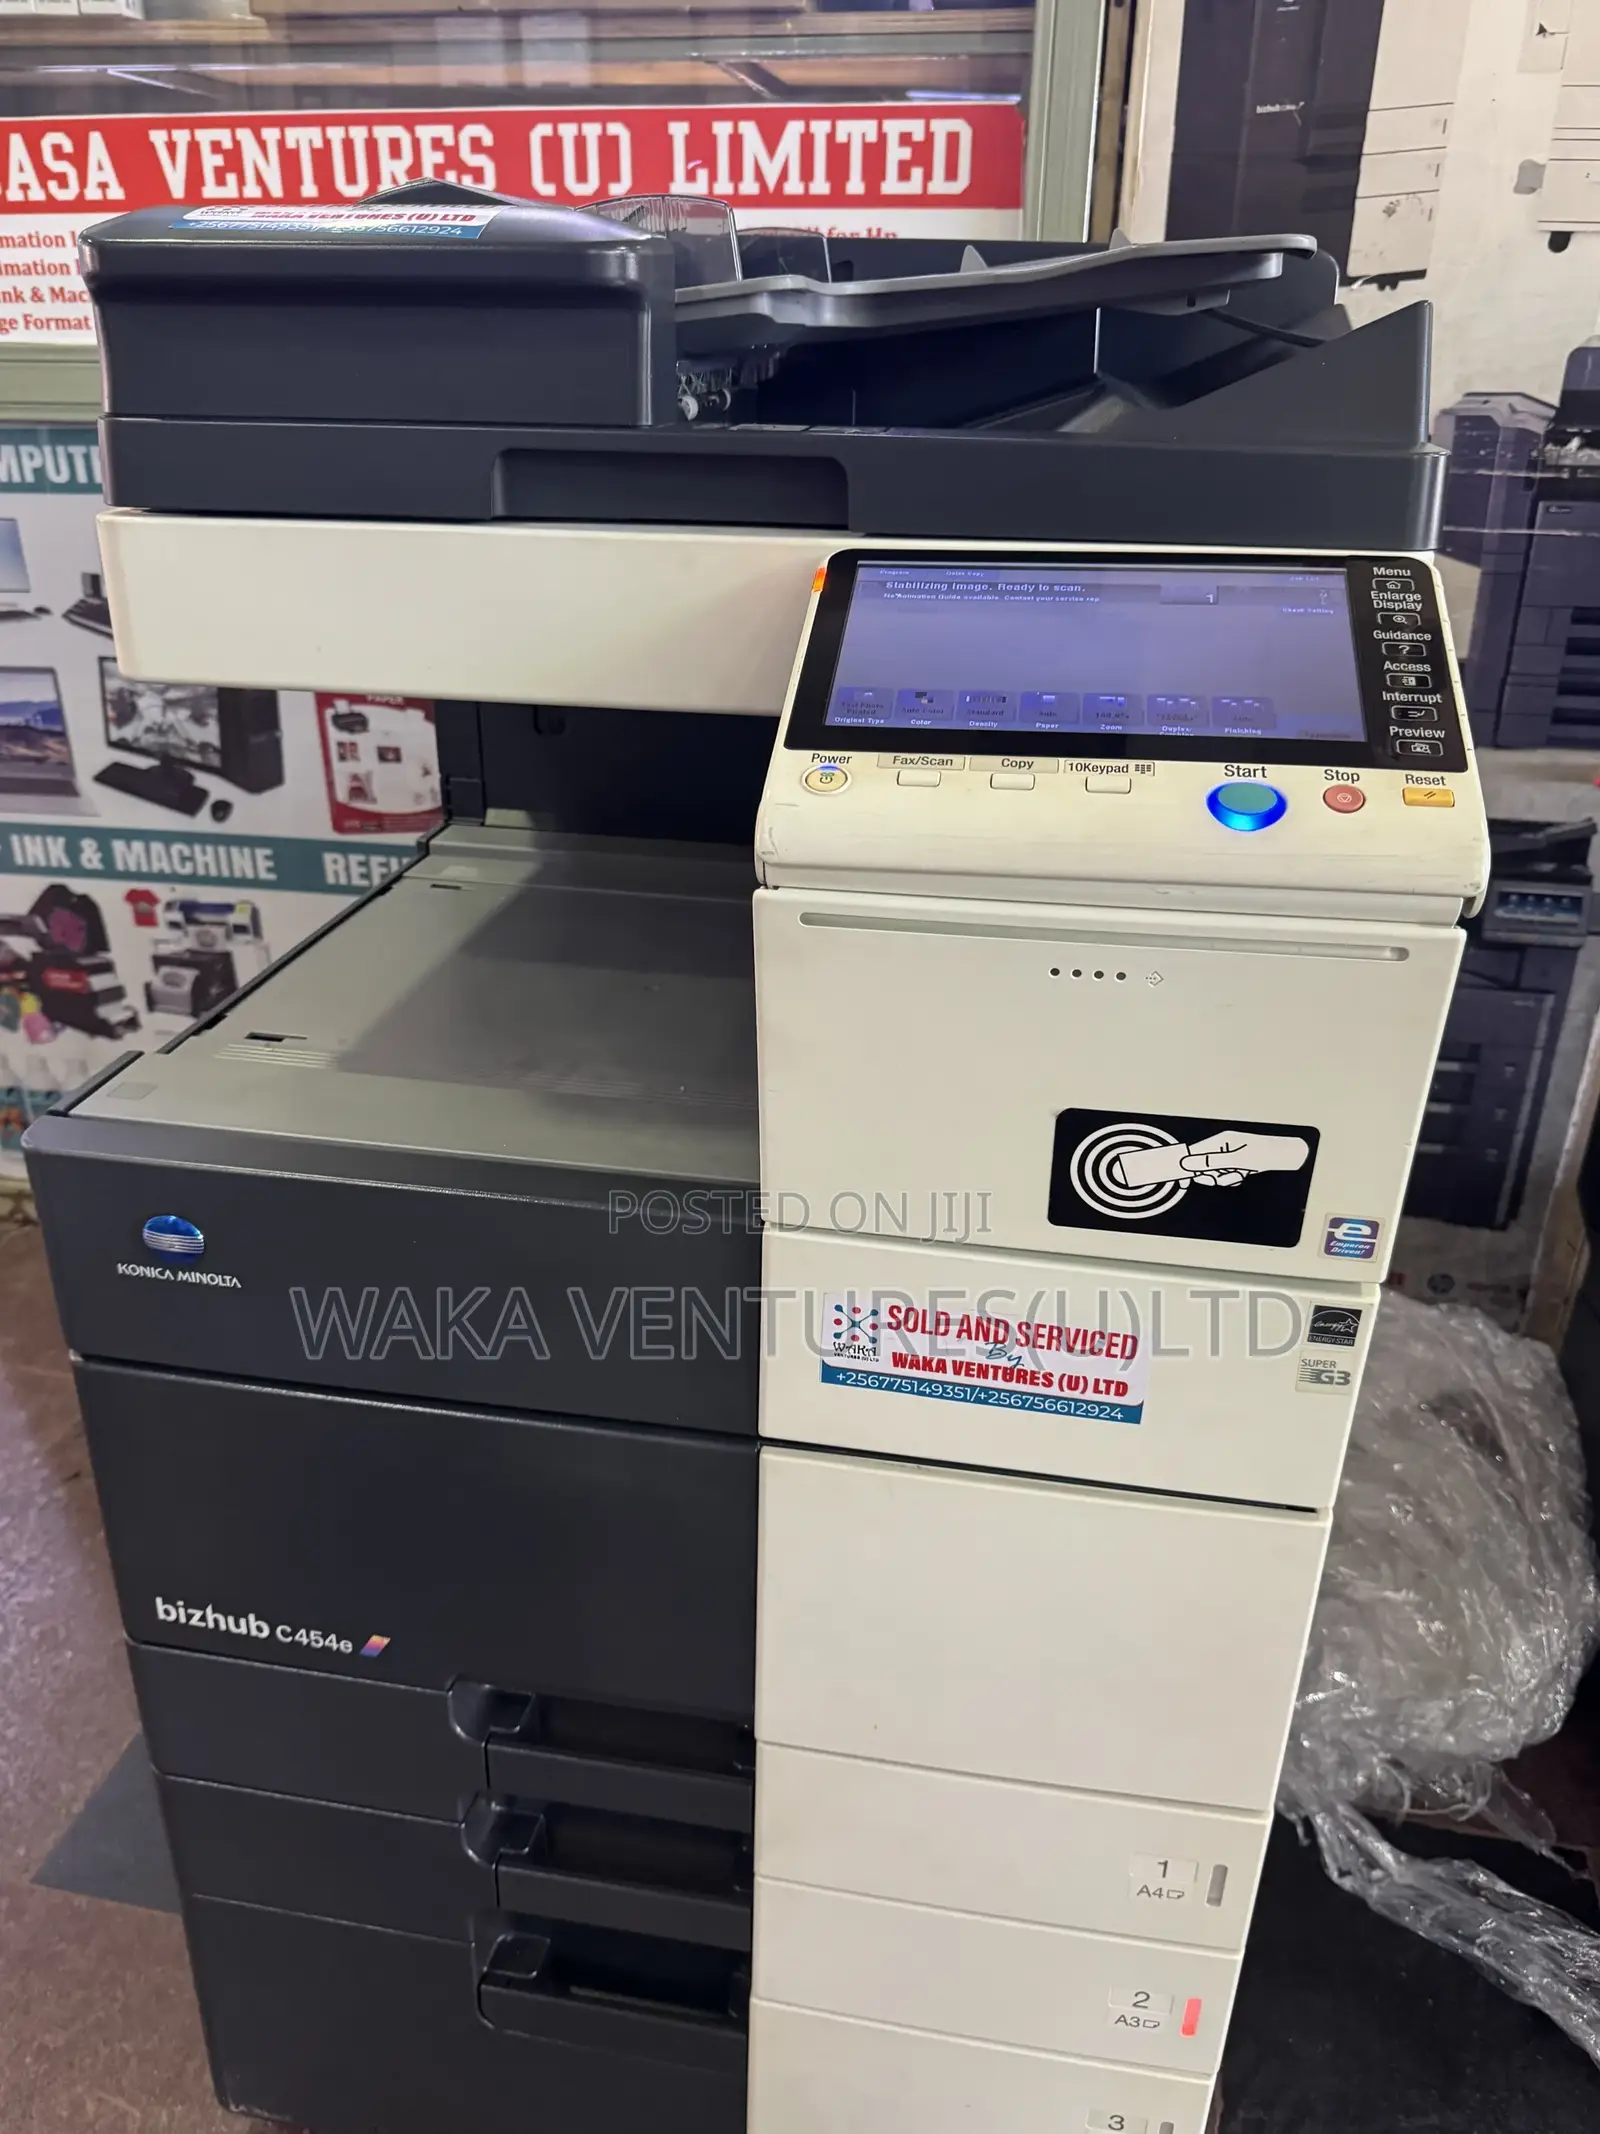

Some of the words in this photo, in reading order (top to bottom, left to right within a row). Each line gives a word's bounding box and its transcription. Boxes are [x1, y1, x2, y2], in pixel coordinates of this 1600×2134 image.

[0, 131, 126, 201] ASA
[148, 123, 497, 200] VENTURES
[529, 121, 632, 197] (U)
[667, 118, 973, 196] LIMITED
[439, 213, 477, 221] LTD
[31, 286, 44, 303] &
[49, 286, 91, 303] Mac
[23, 313, 92, 330] Format
[1373, 567, 1411, 577] Menu
[885, 581, 948, 591] Stabilizing
[998, 583, 1034, 593] Ready
[1371, 591, 1422, 601] Enlarge
[1373, 600, 1422, 611] Display
[1373, 630, 1432, 641] Guidance
[1383, 661, 1431, 672] Access
[1382, 691, 1443, 704] Interrupt
[1224, 727, 1262, 735] Finishing
[1389, 726, 1445, 739] Preview
[811, 753, 852, 764] Power
[892, 756, 953, 767] Fax/Scan
[1001, 758, 1034, 769] Copy
[1068, 763, 1129, 774] 10Keypad
[1224, 764, 1267, 778] Start
[1324, 769, 1360, 783] Stop
[1405, 774, 1446, 786] Reset
[10, 834, 71, 868] INK
[80, 838, 104, 870] &
[111, 840, 278, 880] MACHINE
[1331, 1247, 1366, 1255] Driven!
[117, 1262, 174, 1280] KONICA
[177, 1270, 242, 1289] MINOLTA
[887, 1304, 950, 1337] SOLD
[956, 1314, 1010, 1345] AND
[1015, 1320, 1139, 1361] SERVICED
[833, 1341, 877, 1357] WAKA
[984, 1342, 1025, 1369] By
[1301, 1358, 1337, 1369] SUPER
[891, 1351, 948, 1376] WAKA
[952, 1358, 1055, 1390] VENTURES
[1057, 1374, 1089, 1395] (U)
[1092, 1379, 1129, 1398] LTD
[1316, 1370, 1351, 1386] G3
[836, 1371, 1124, 1421] +256775149351/+256756612924
[155, 1596, 270, 1639] bizhub
[275, 1624, 353, 1654] C454e
[1157, 1860, 1169, 1879] 1
[1136, 1884, 1164, 1900] A4
[1132, 1991, 1151, 2009] 2
[1114, 2014, 1141, 2028] A3
[1107, 2114, 1125, 2131] 3
